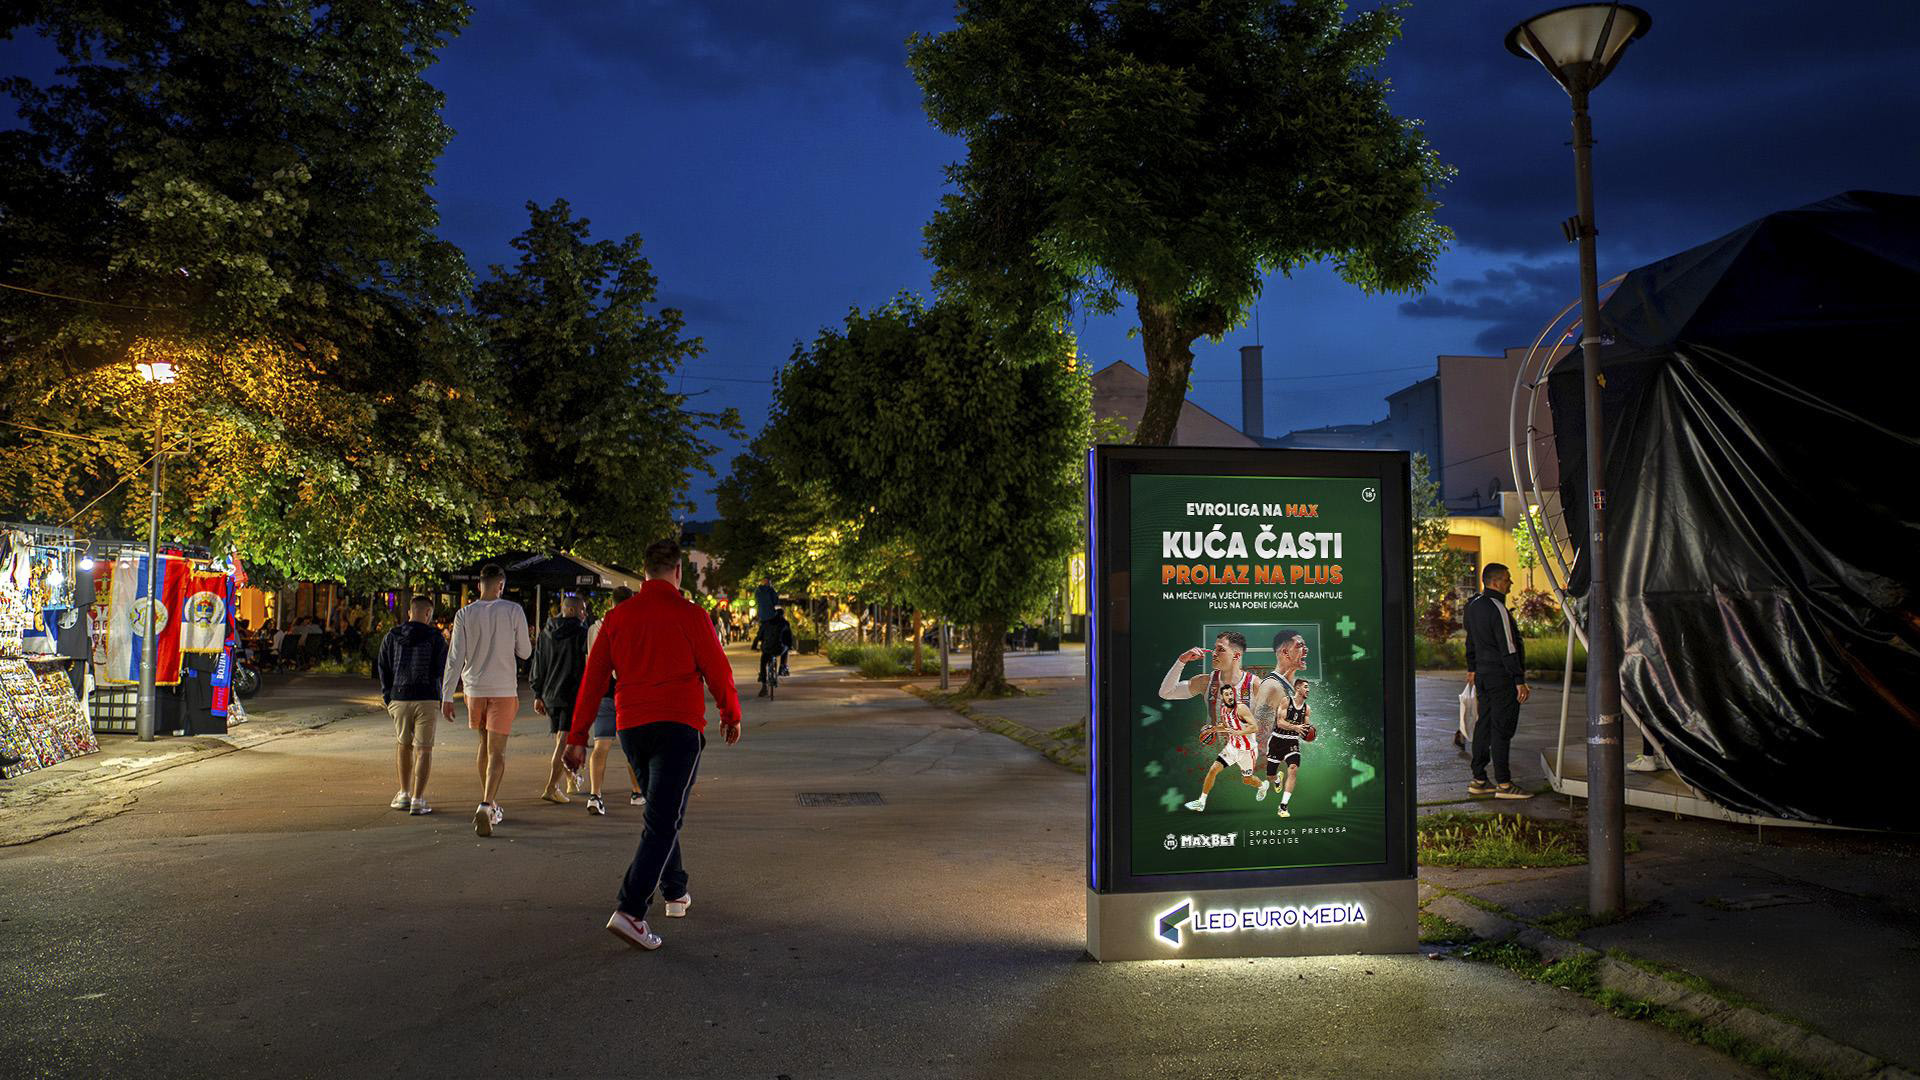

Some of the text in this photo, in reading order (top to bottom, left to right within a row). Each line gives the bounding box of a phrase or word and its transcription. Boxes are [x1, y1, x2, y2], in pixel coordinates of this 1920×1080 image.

[1186, 502, 1319, 518] EVROLIGA NA MAX
[1162, 524, 1343, 560] KUĆA ČASTI
[1161, 564, 1344, 585] PROLAZ NA PLUS
[1162, 590, 1343, 600] NA MEČEVIMA VJEČITIH PRVI KOŠ TI GARANTUJE
[1209, 601, 1228, 609] PLUS
[1229, 601, 1241, 609] NA
[1269, 600, 1299, 609] IGRAČA
[1249, 826, 1347, 837] SPONZOR PRENOSA
[1180, 832, 1238, 849] MAXBET
[1249, 837, 1299, 846] EVROLIGE
[1195, 906, 1366, 931] LED EURO MEDIA
